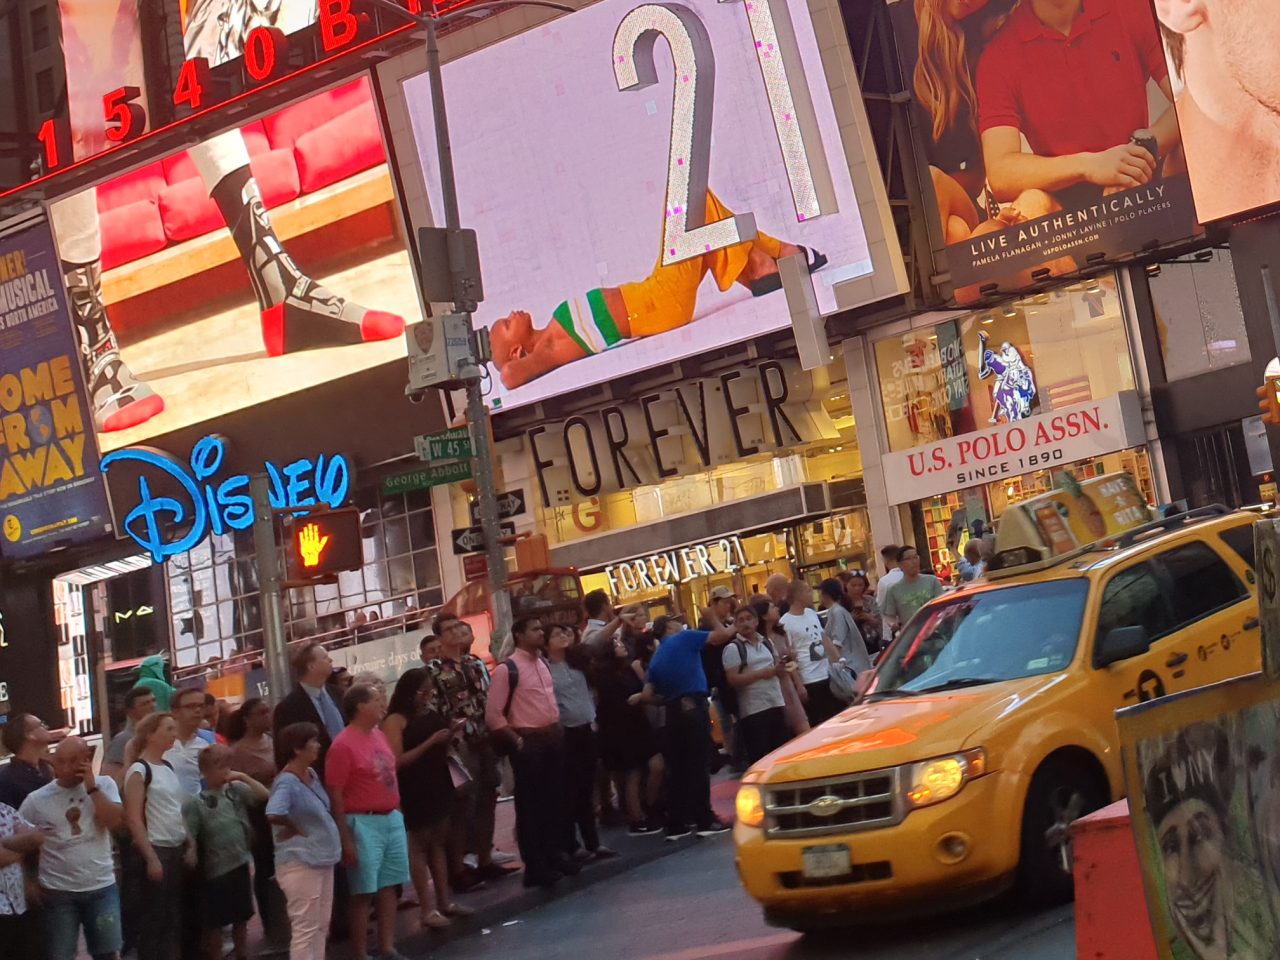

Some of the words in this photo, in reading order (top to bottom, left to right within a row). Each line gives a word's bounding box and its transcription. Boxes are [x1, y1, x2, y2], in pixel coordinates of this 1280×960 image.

[971, 234, 1008, 256] LIVE
[1018, 184, 1166, 242] AUTHENTICALLY
[972, 253, 1001, 267] PAMELA
[1002, 241, 1042, 259] FLANAGAN
[1051, 229, 1078, 244] JONNY
[1080, 220, 1108, 235] LAVINE
[1114, 211, 1136, 225] POLO
[1137, 201, 1172, 217] PLAYERS
[0, 355, 77, 414] OME
[432, 442, 442, 457] W
[447, 441, 460, 456] 45
[527, 359, 803, 509] FOREVER
[907, 445, 954, 478] U.S.
[957, 426, 1027, 466] POLO
[1034, 405, 1110, 447] ASSN.
[0, 431, 87, 502] AWAY
[386, 471, 427, 490] George
[430, 462, 470, 479] Abbott
[956, 460, 1011, 485] SINCE
[1018, 448, 1064, 469] 1890
[605, 544, 716, 598] FOREVER
[719, 536, 747, 573] 21
